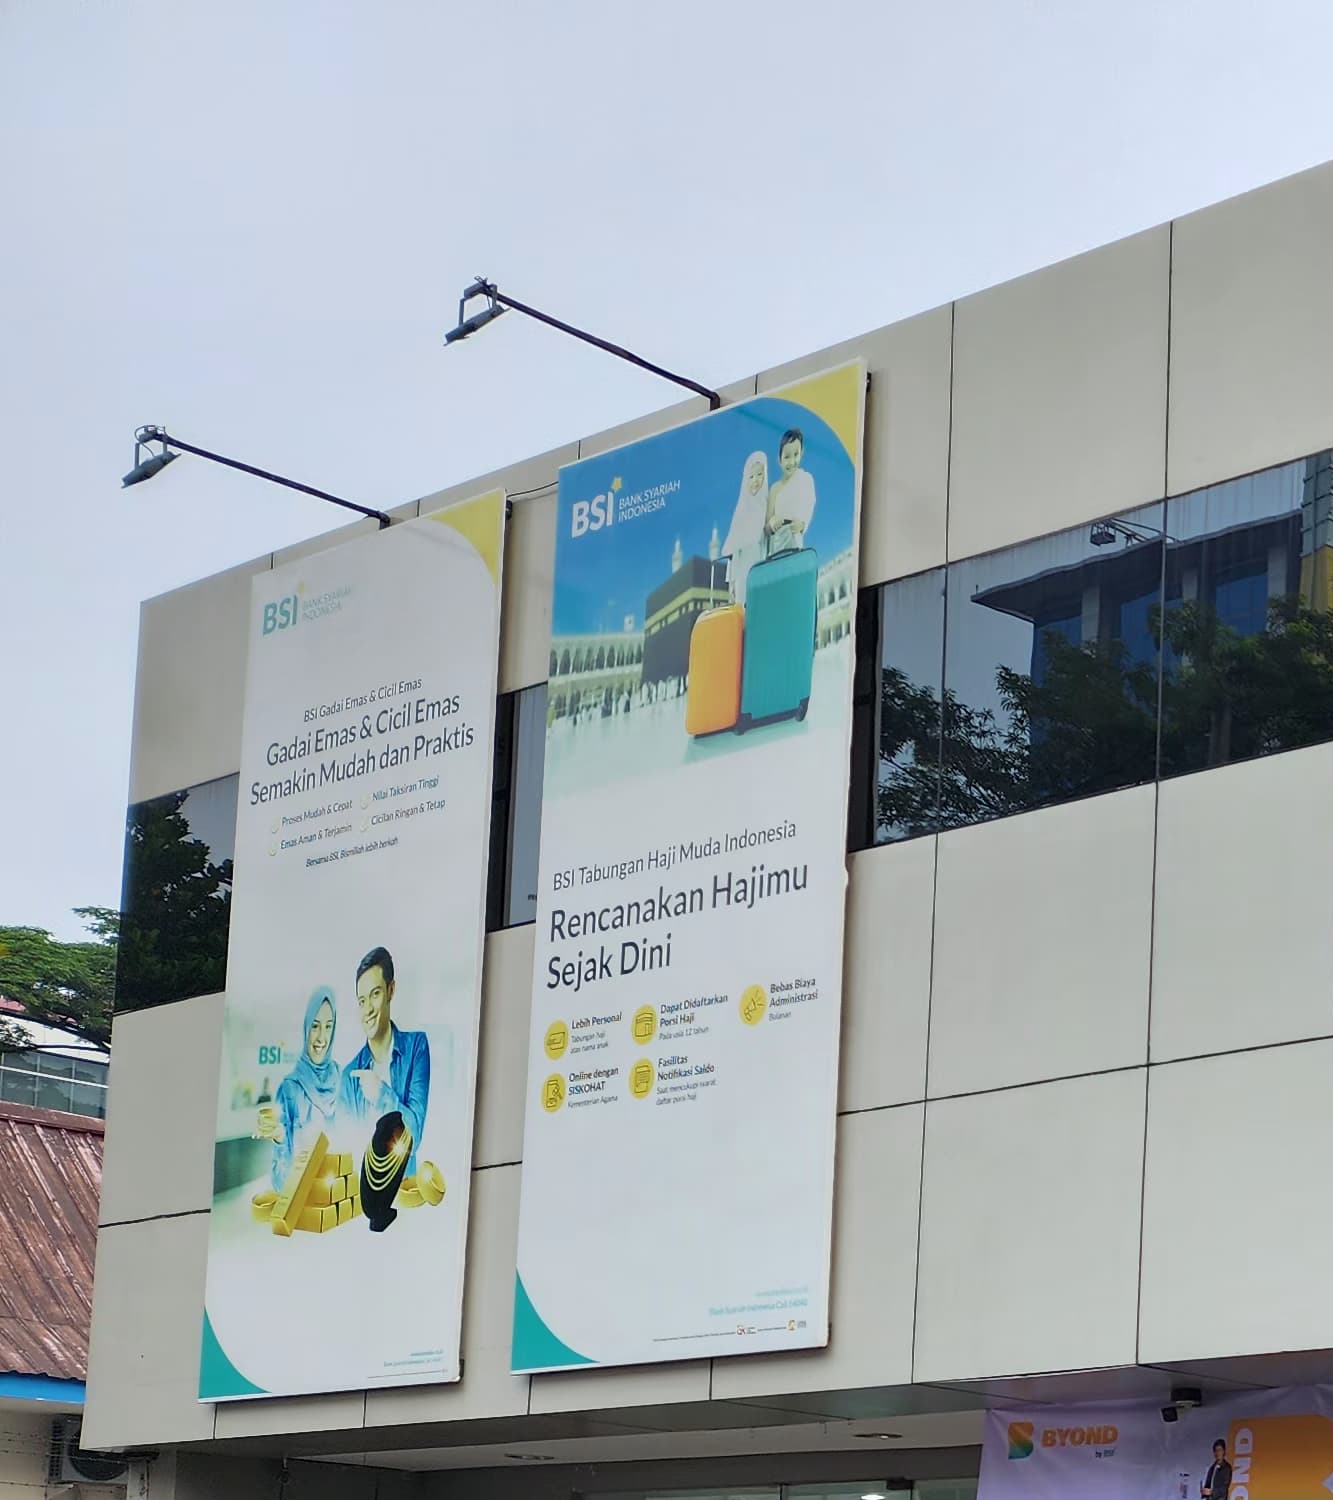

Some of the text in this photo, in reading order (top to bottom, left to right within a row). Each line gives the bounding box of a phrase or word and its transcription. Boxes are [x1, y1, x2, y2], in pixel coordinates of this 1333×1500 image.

[619, 480, 680, 510] BANK SYARIAH
[571, 491, 614, 538] BSI
[618, 497, 666, 523] INDONESIA
[263, 594, 298, 635] BSI
[304, 678, 422, 723] BSI Gadai Emas & Cicil Emas
[266, 695, 460, 766] Gadai Emas & Cicil Emas
[250, 723, 474, 806] Semakin Mudah dan Praktis
[390, 783, 417, 797] Taksiran
[418, 776, 440, 791] Tinggi
[303, 806, 326, 820] Mudah
[371, 812, 394, 826] Cicilan
[395, 806, 418, 822] Ringan
[553, 820, 796, 891] BSI Tabungan Haji Muda Indonesia
[550, 863, 808, 943] Rencanakan Hajimu
[547, 933, 672, 993] Sejak Dini
[770, 978, 816, 995] Bebas Biaya
[660, 993, 728, 1017] Dapat Didaftarkan
[768, 988, 819, 1009] Administrasi
[571, 1011, 622, 1030] Lebih Personal
[659, 1011, 696, 1028] Porsi Haji
[258, 1045, 280, 1065] BSI
[658, 1055, 688, 1068] Fasilitas
[569, 1066, 619, 1083] Online dengan
[657, 1063, 715, 1081] Notifikasi Saldo
[568, 1080, 606, 1096] SISKOHAT
[1041, 1425, 1119, 1448] BYOND
